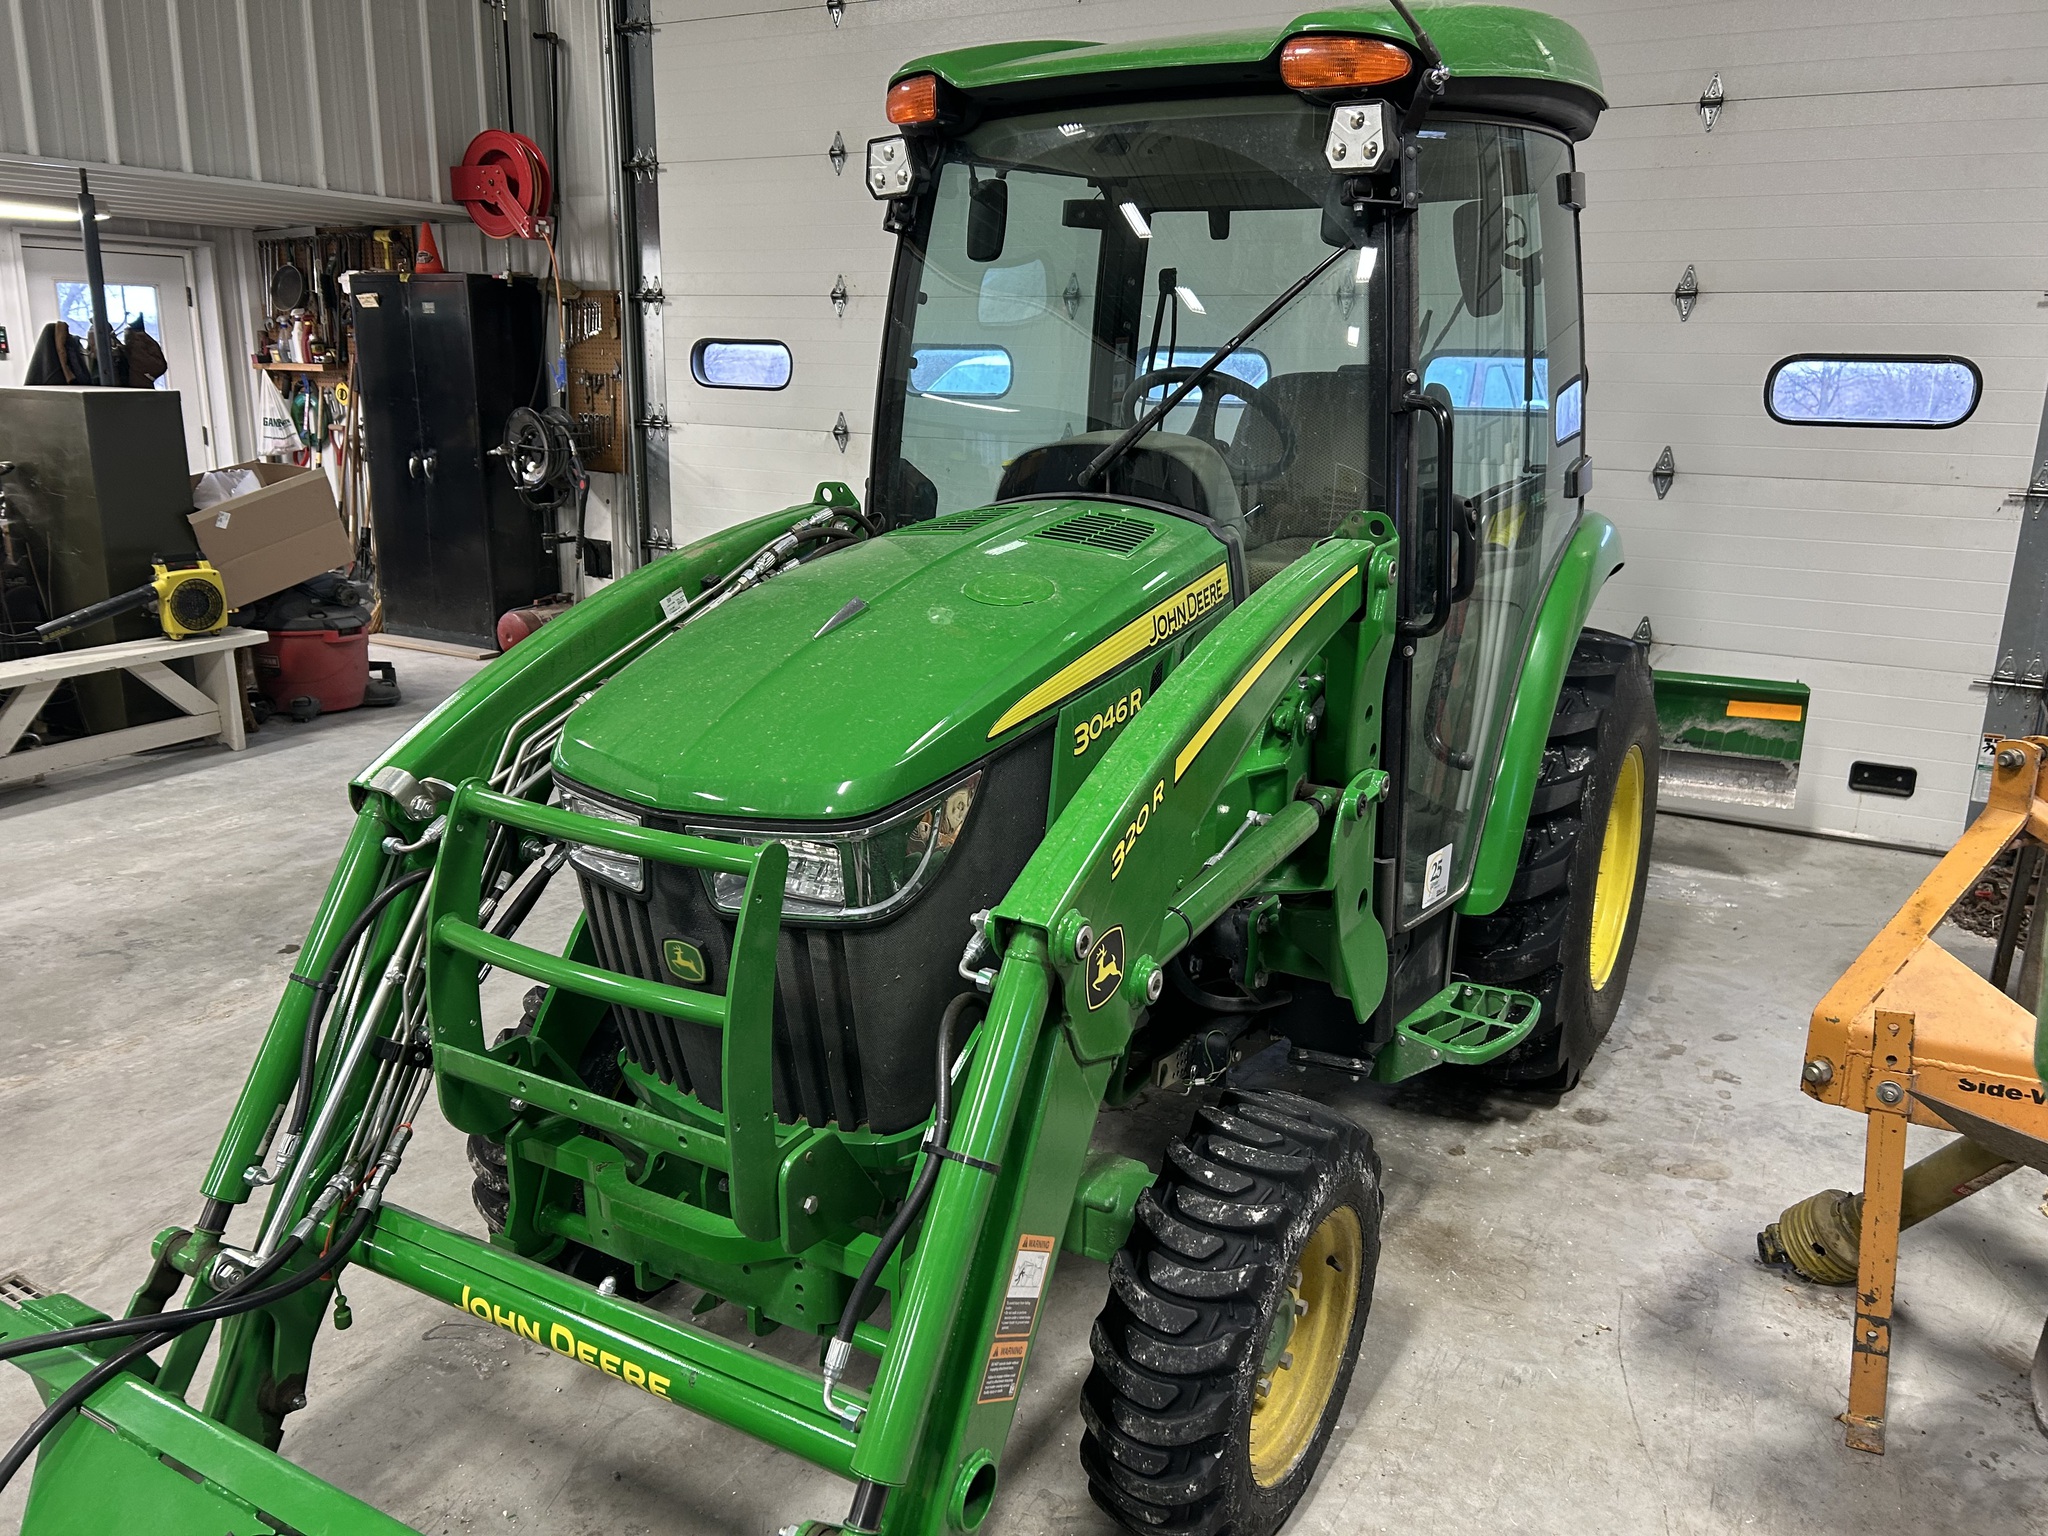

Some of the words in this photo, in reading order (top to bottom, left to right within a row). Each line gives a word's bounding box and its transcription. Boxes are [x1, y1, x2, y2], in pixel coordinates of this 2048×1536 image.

[1149, 602, 1187, 645] JOHN
[1186, 578, 1223, 621] DEERE
[1028, 1239, 1051, 1250] WARNING
[453, 1285, 543, 1345] JOHN
[550, 1322, 673, 1402] DEERE
[1000, 1345, 1024, 1356] WARNING
